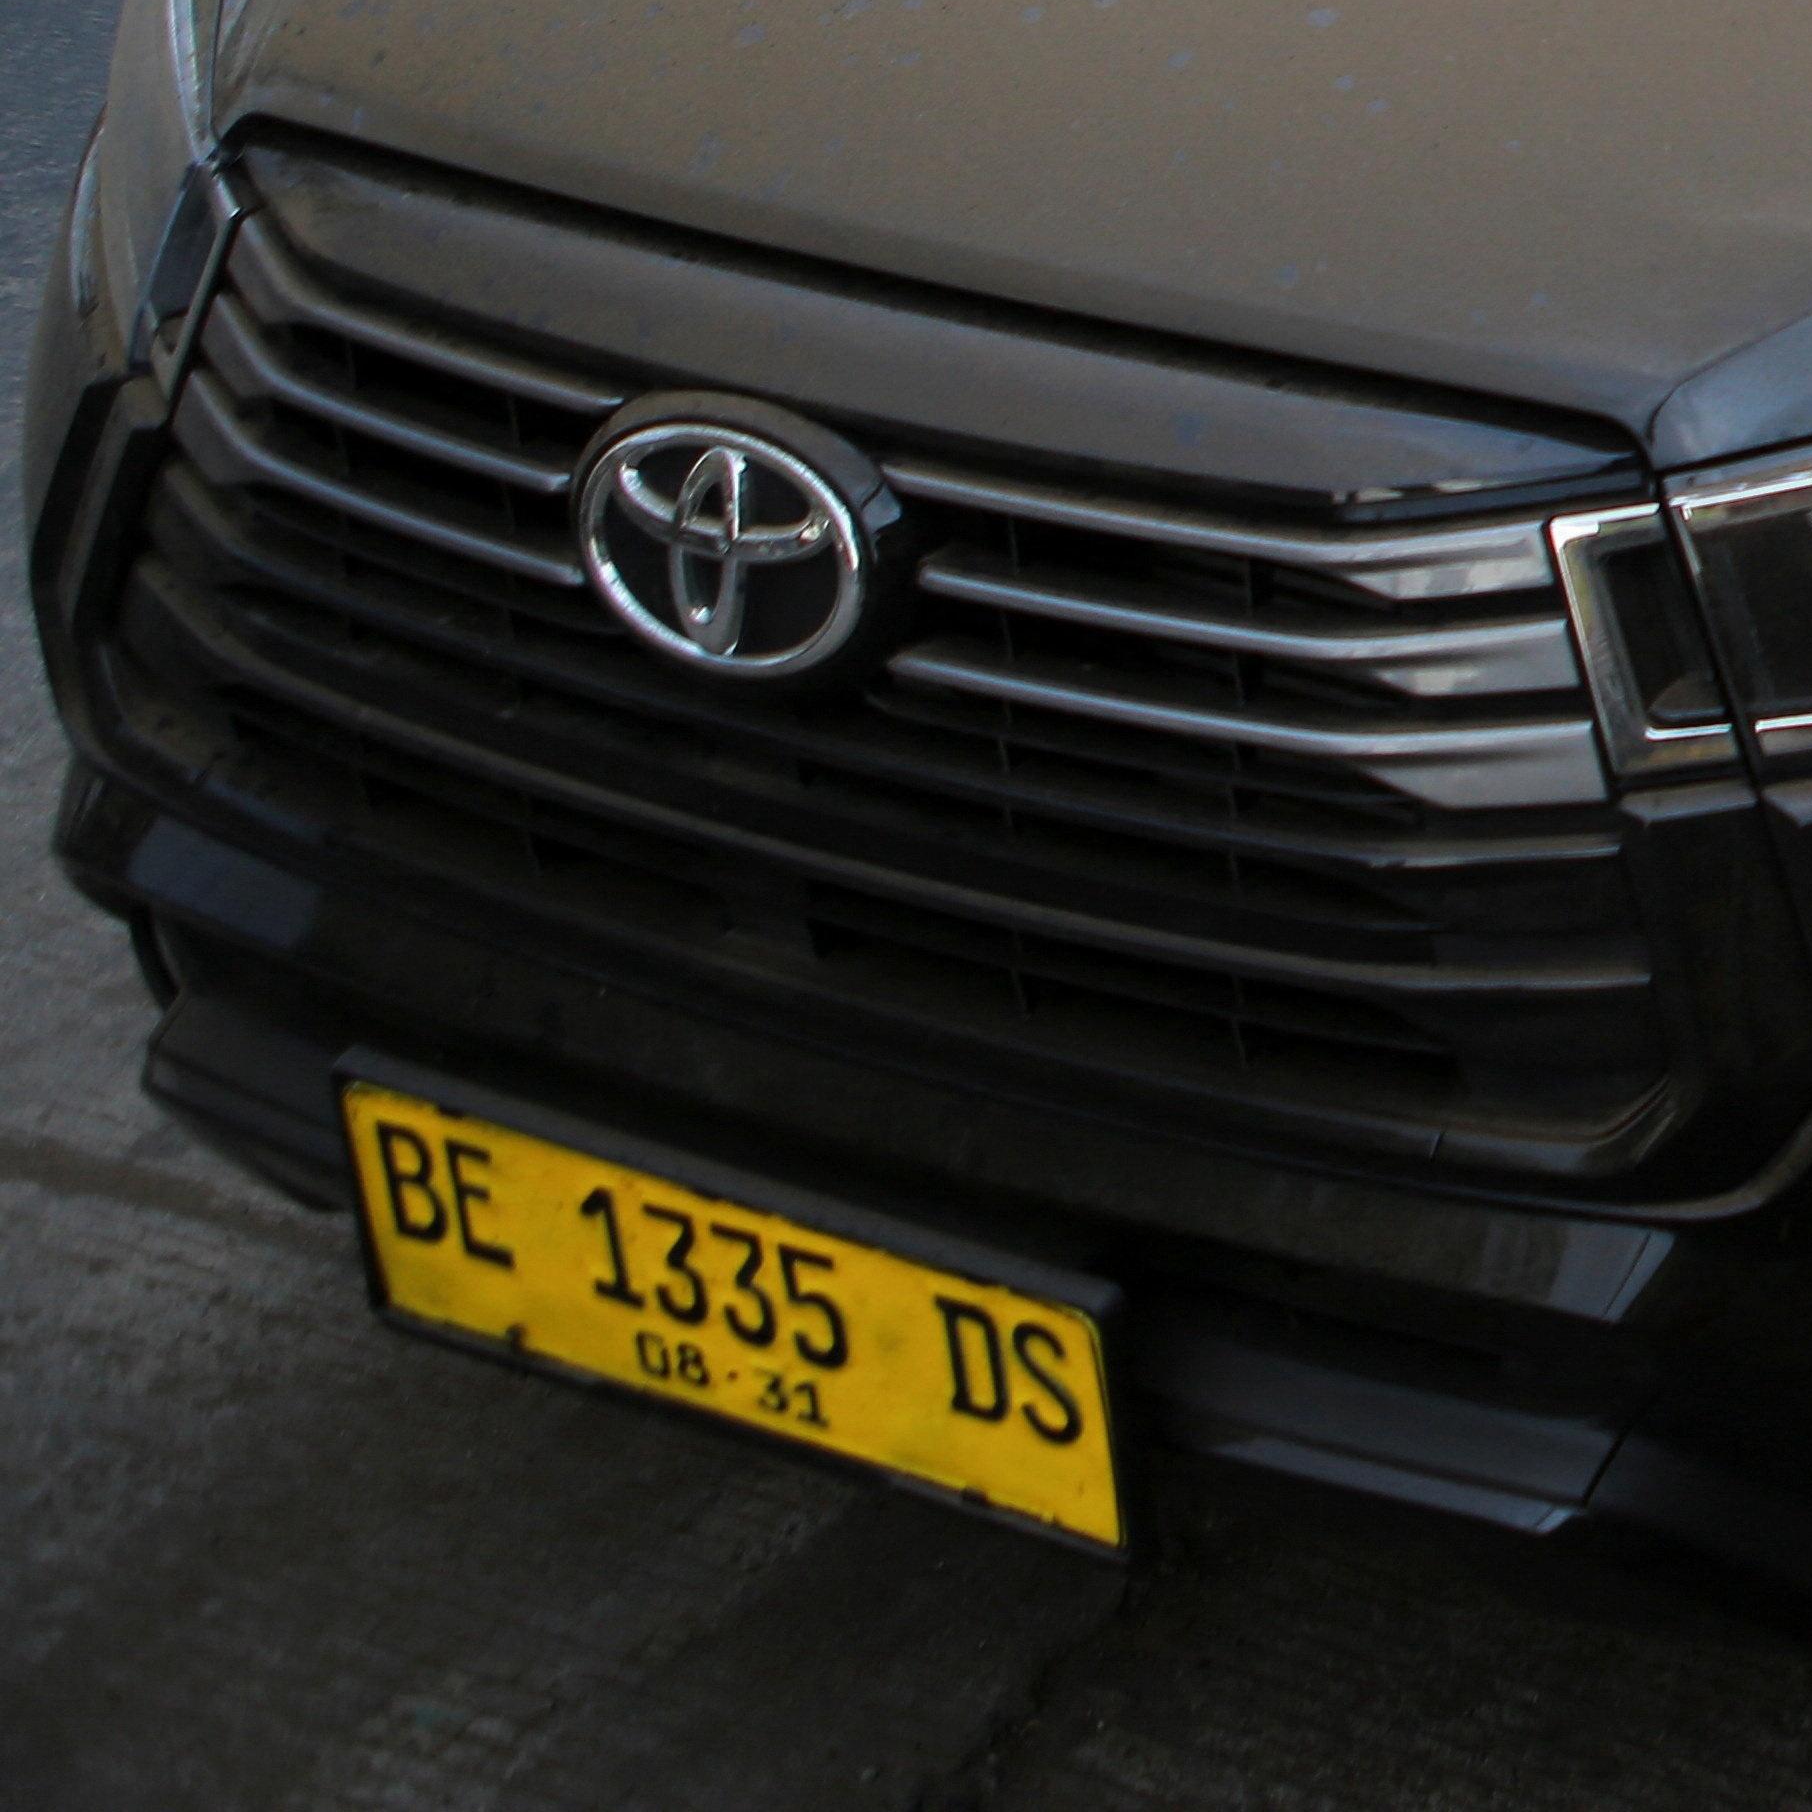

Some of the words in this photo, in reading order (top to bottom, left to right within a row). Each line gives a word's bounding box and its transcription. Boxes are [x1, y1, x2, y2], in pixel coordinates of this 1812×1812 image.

[374, 1118, 516, 1270] BE
[578, 1187, 850, 1369] 1335
[933, 1294, 1083, 1446] DS
